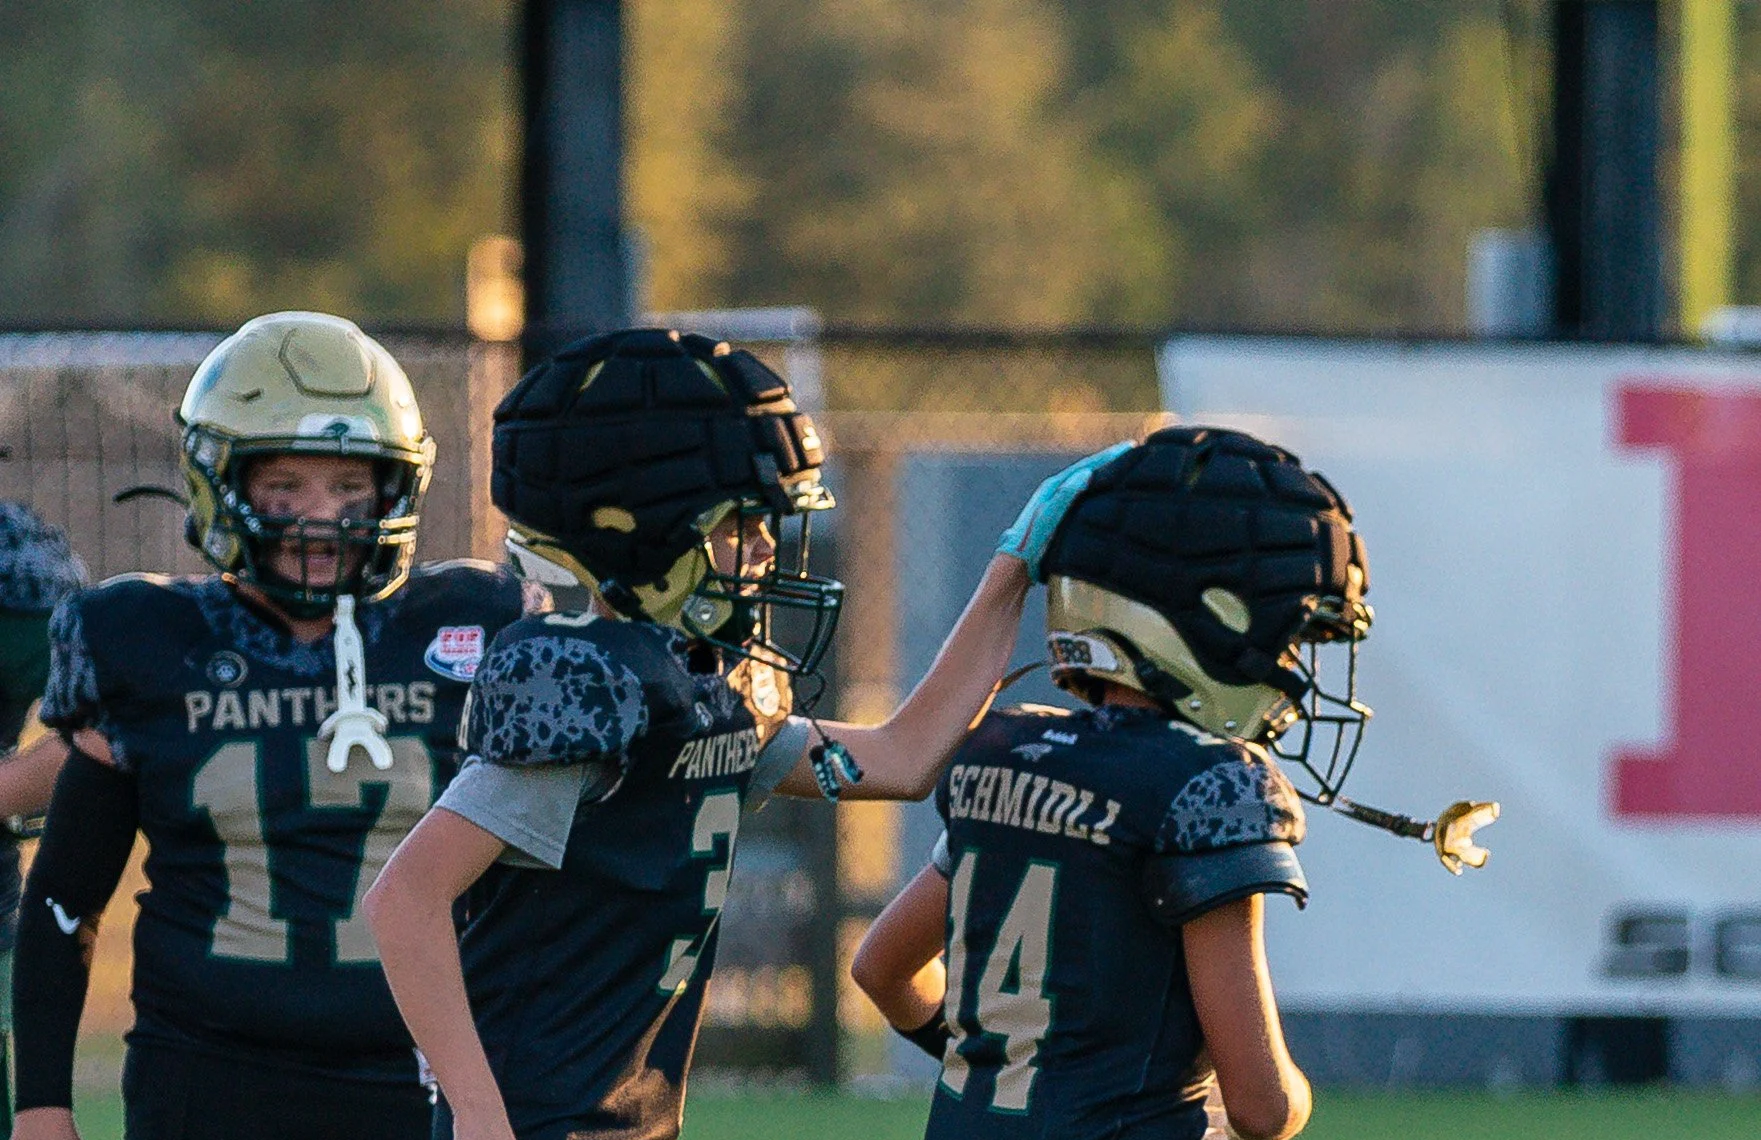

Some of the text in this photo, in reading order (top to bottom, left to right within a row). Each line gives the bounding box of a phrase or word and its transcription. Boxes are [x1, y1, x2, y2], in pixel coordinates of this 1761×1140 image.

[185, 681, 436, 733] PANTHRS
[193, 738, 433, 962] 17
[941, 851, 1057, 1111] 14
